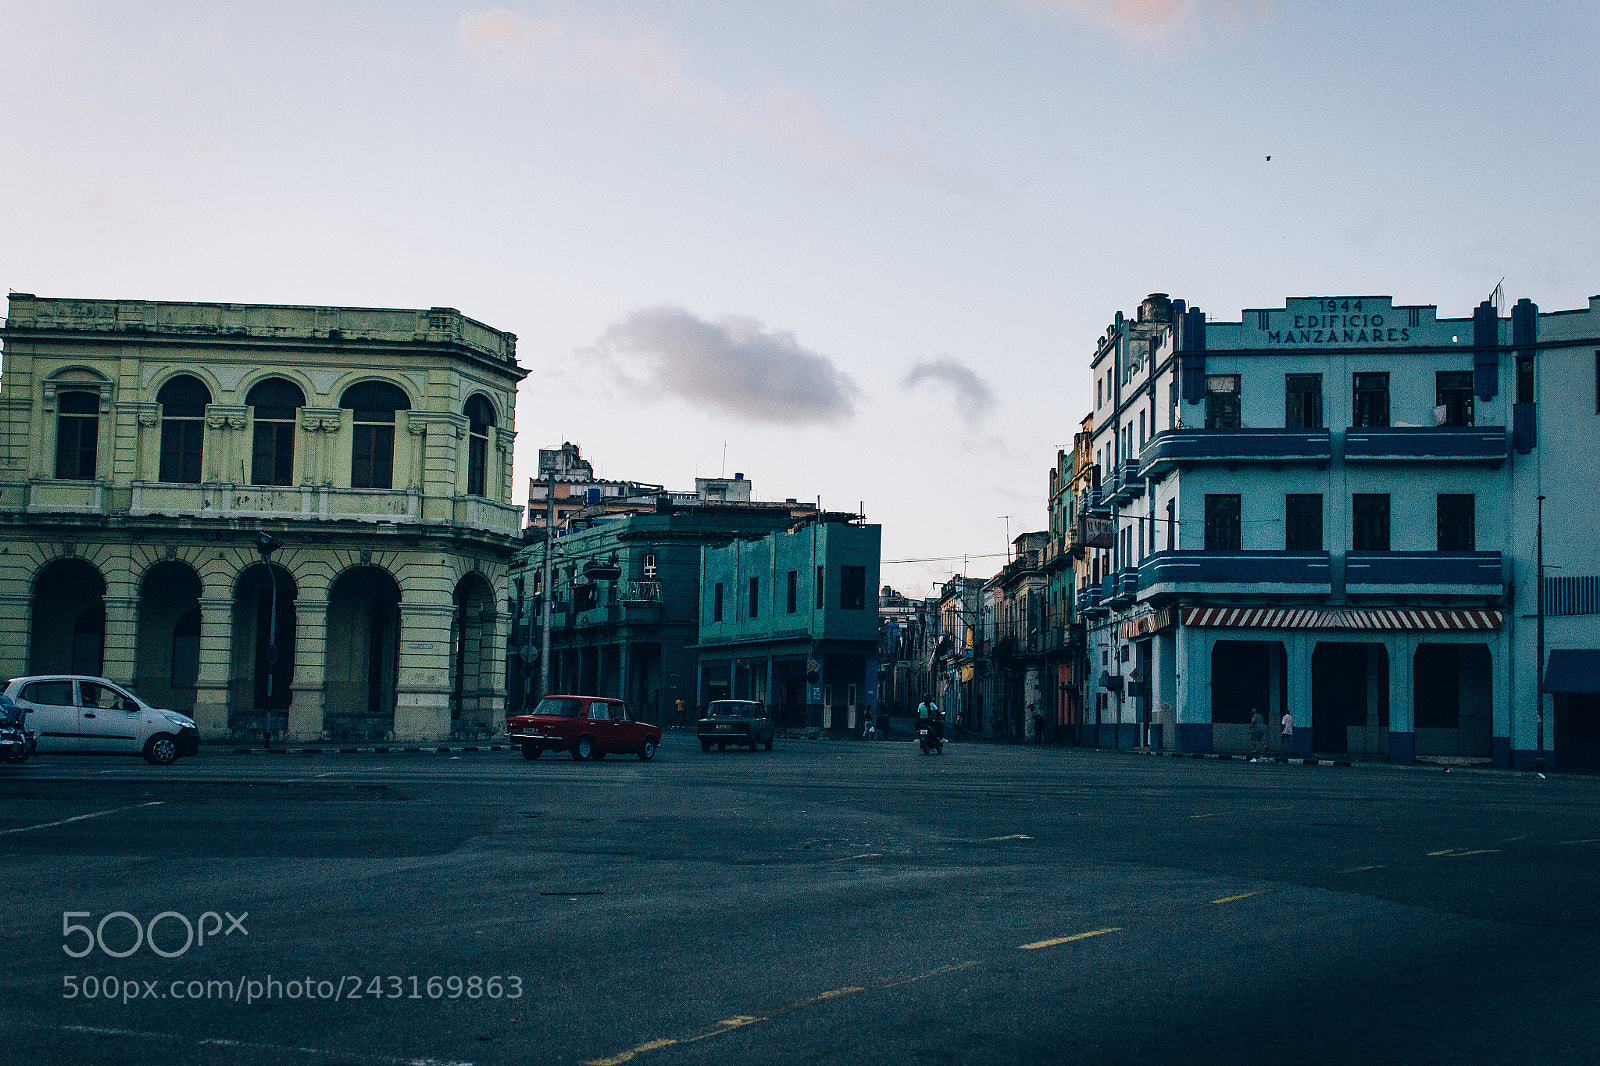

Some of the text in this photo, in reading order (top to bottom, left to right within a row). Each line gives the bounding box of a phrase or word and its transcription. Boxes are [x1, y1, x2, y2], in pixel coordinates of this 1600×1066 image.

[1319, 299, 1363, 313] 1944
[1294, 314, 1384, 329] EDIFICIO
[1268, 328, 1410, 344] MANZANARES
